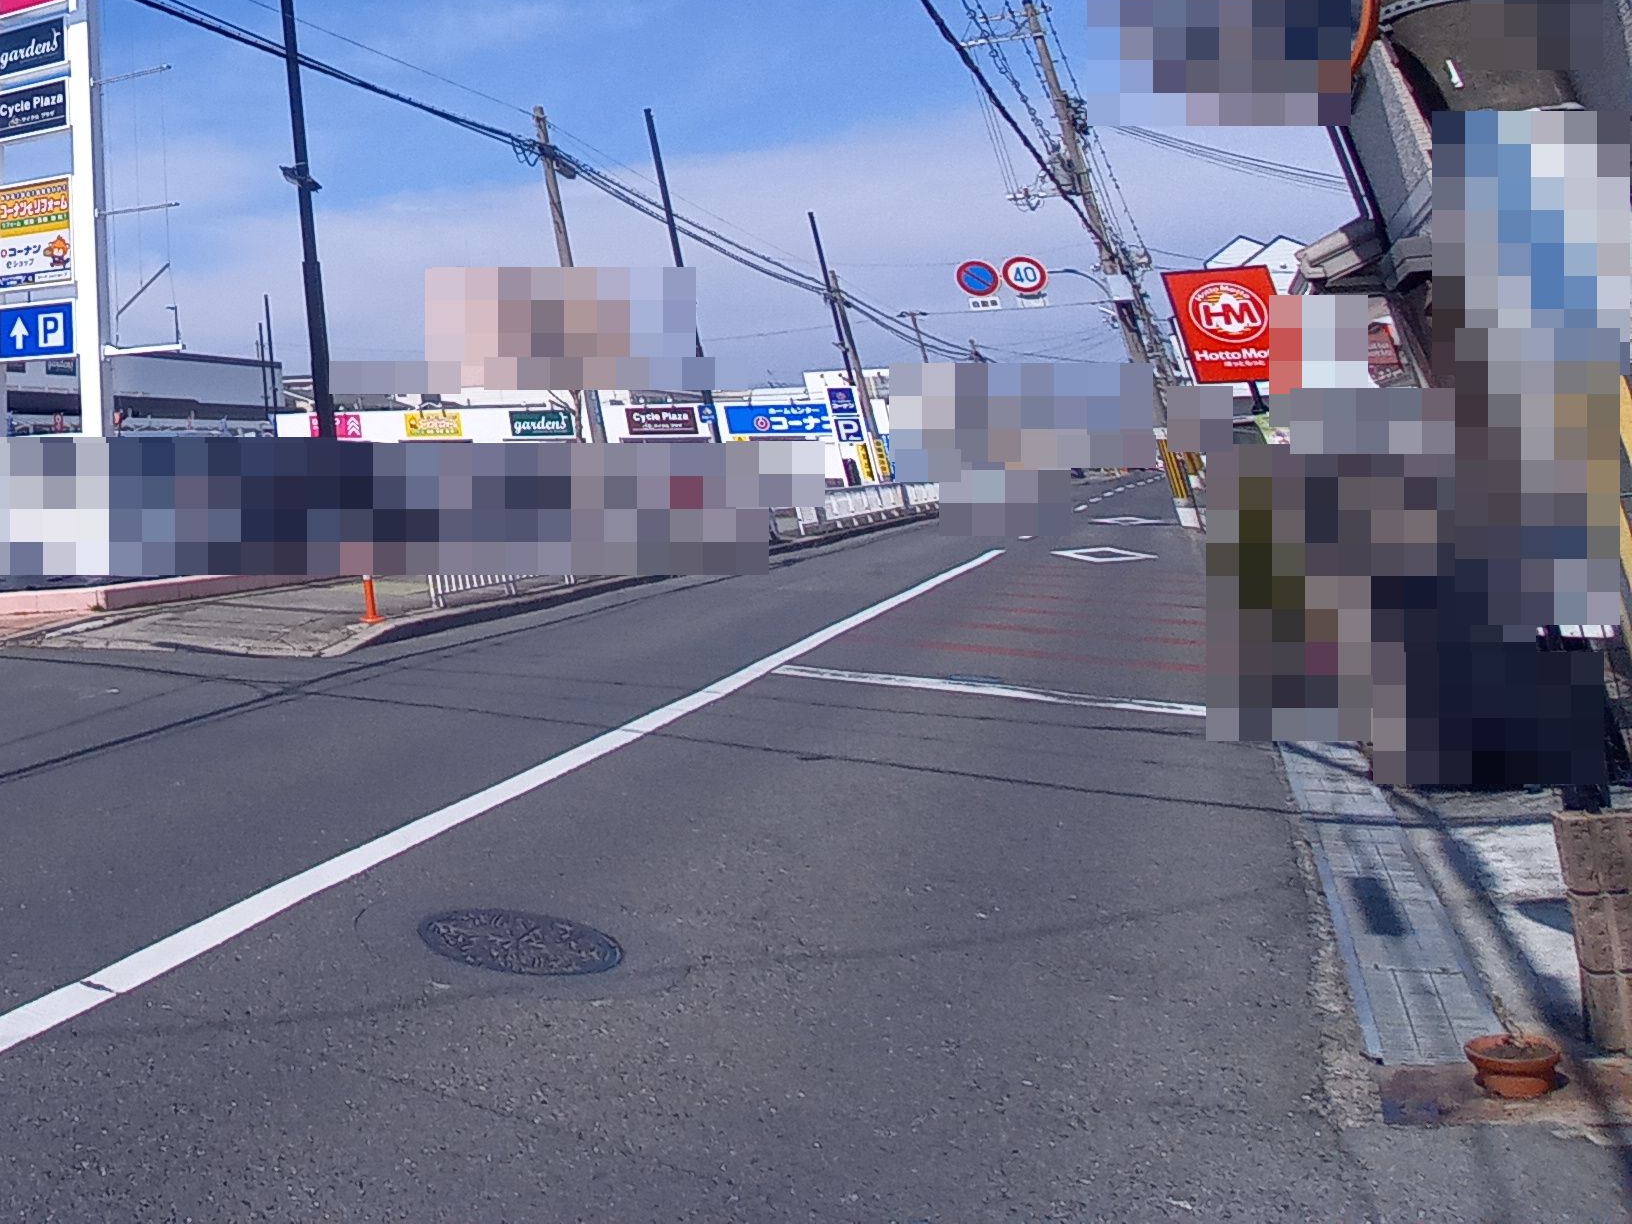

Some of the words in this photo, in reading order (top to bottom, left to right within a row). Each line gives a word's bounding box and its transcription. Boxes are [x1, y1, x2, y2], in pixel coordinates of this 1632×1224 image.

[0, 28, 61, 70] gardens
[0, 99, 31, 118] Cycle
[33, 94, 64, 109] Plaza
[8, 244, 41, 257] コーナン
[1014, 266, 1037, 283] 40
[1202, 302, 1259, 327] HM
[43, 316, 59, 344] P
[1194, 349, 1241, 362] Hotto
[513, 411, 568, 435] gardens
[632, 411, 660, 424] Cycle
[661, 411, 689, 421] Plaza
[837, 419, 859, 440] P
